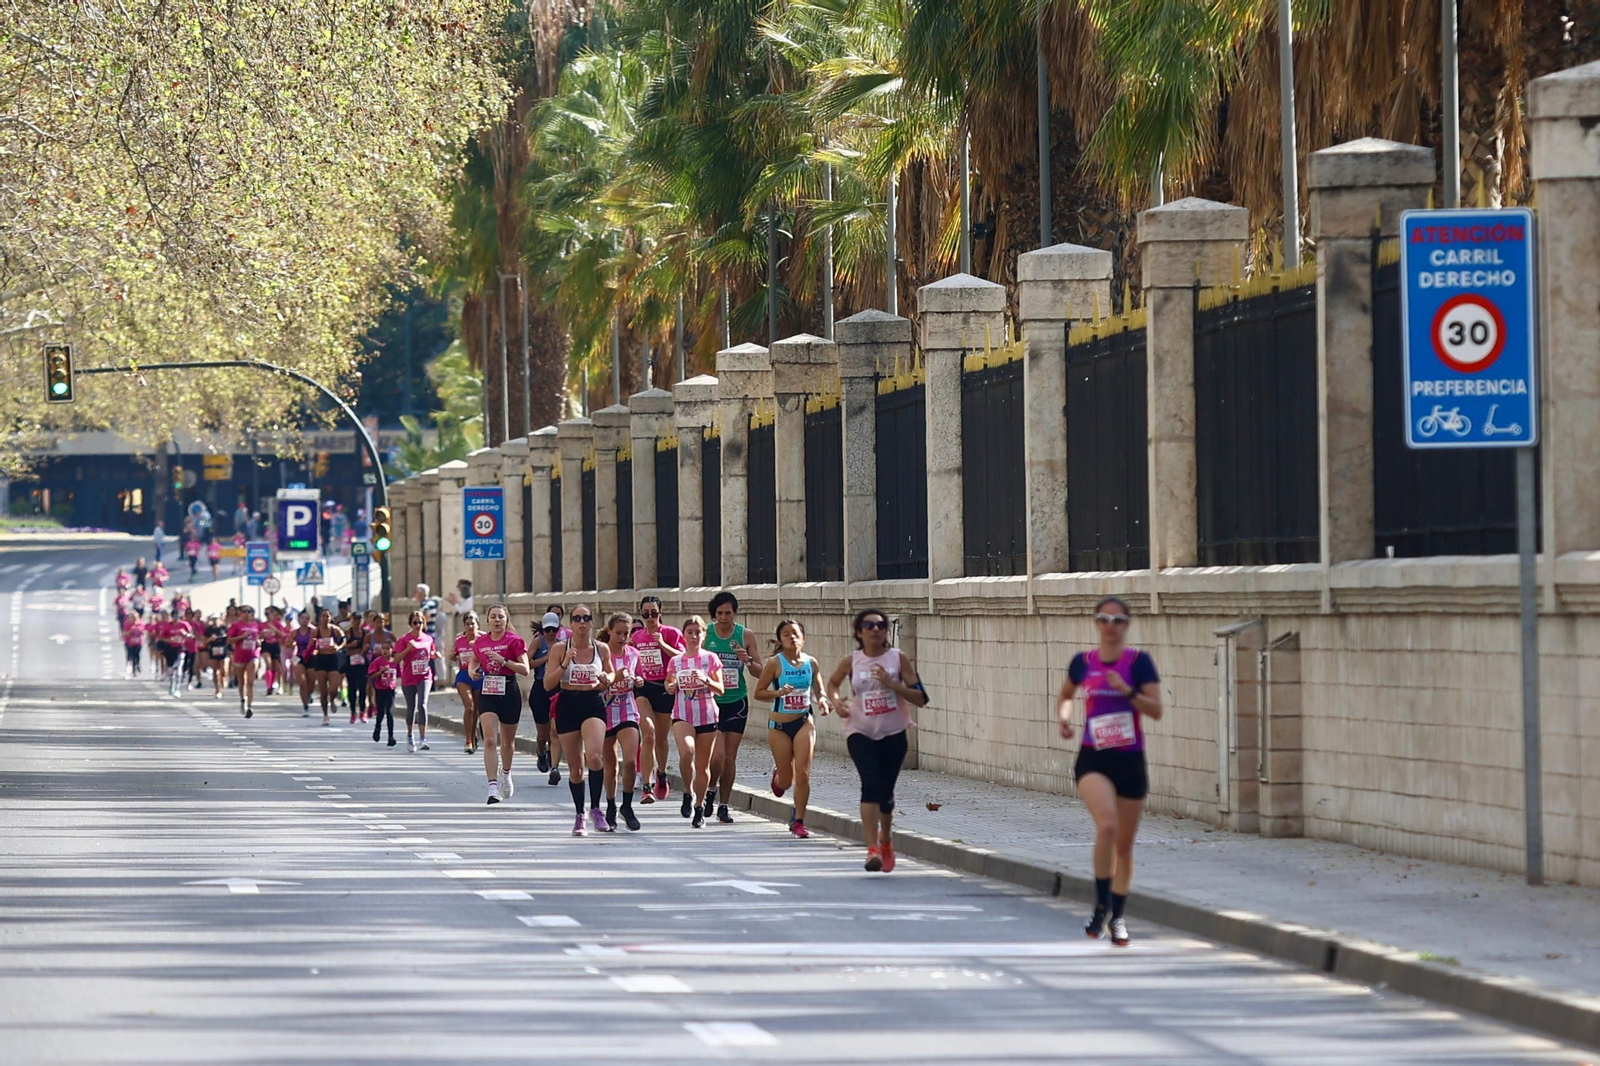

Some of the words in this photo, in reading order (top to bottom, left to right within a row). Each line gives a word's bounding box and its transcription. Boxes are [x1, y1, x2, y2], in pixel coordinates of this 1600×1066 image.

[1411, 224, 1524, 244] ATENCIÓN
[1430, 249, 1503, 267] CARRIL
[1418, 270, 1516, 288] DERECHO
[1448, 321, 1489, 346] 30
[1412, 379, 1527, 397] PREFERENCIA
[287, 505, 312, 537] P
[477, 520, 491, 529] 30
[572, 671, 590, 679] 2079
[785, 669, 807, 677] nerja
[788, 696, 802, 704] 114
[866, 699, 887, 709] 2408
